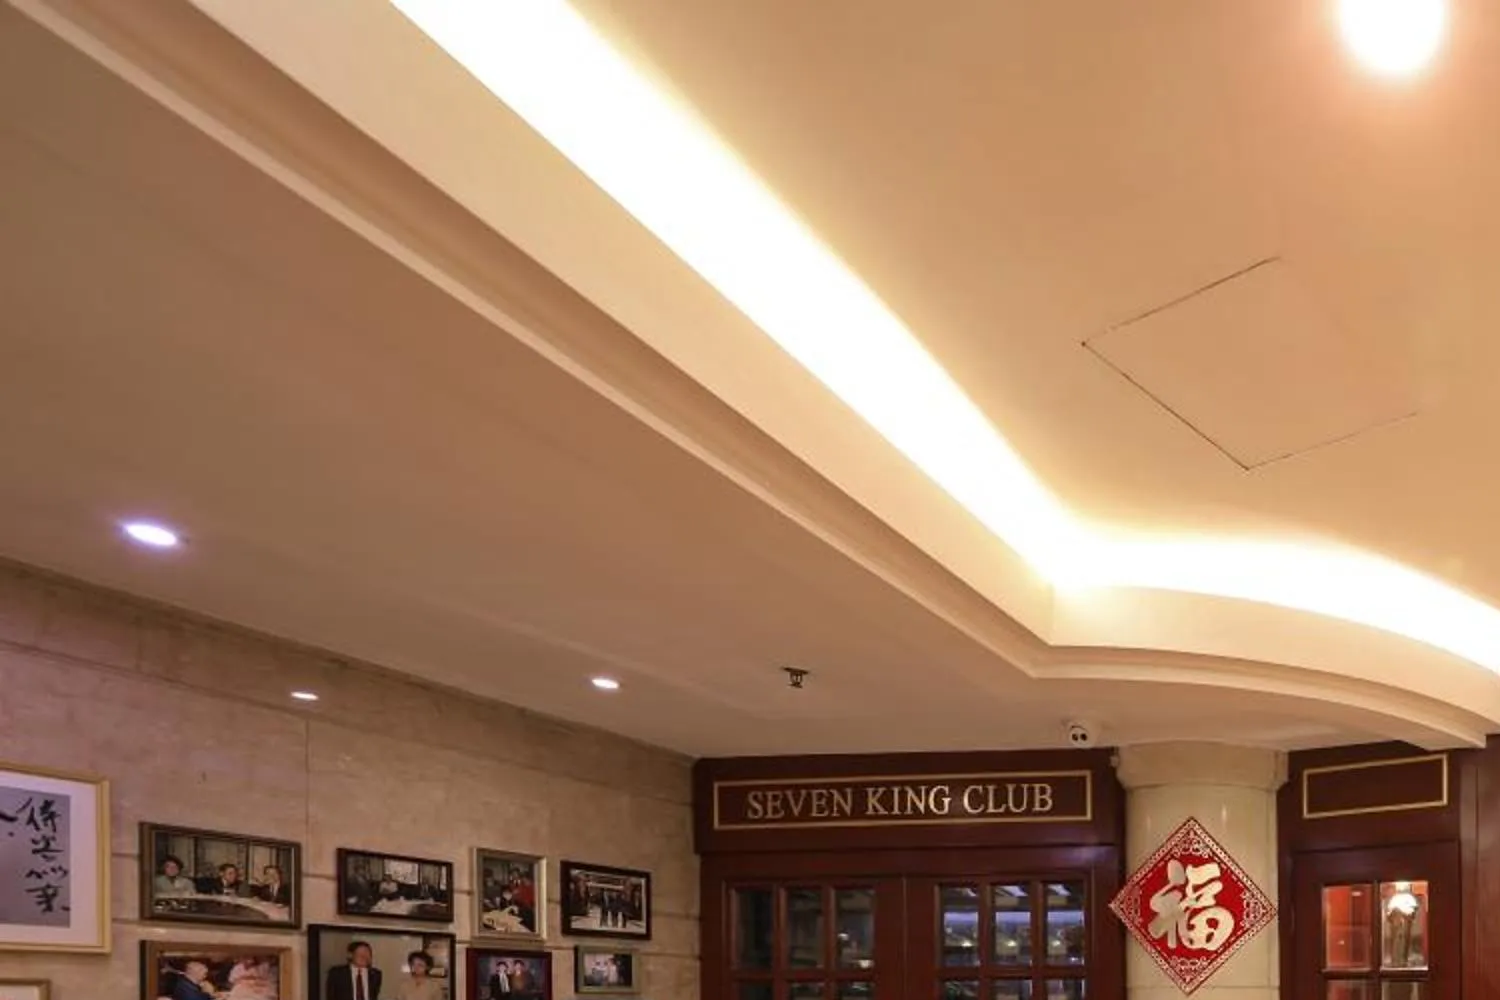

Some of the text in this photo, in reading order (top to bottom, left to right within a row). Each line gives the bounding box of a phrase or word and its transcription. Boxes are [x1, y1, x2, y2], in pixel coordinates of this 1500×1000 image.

[746, 783, 1055, 821] SEVEN KING CLUB
[1147, 858, 1236, 951] 福
